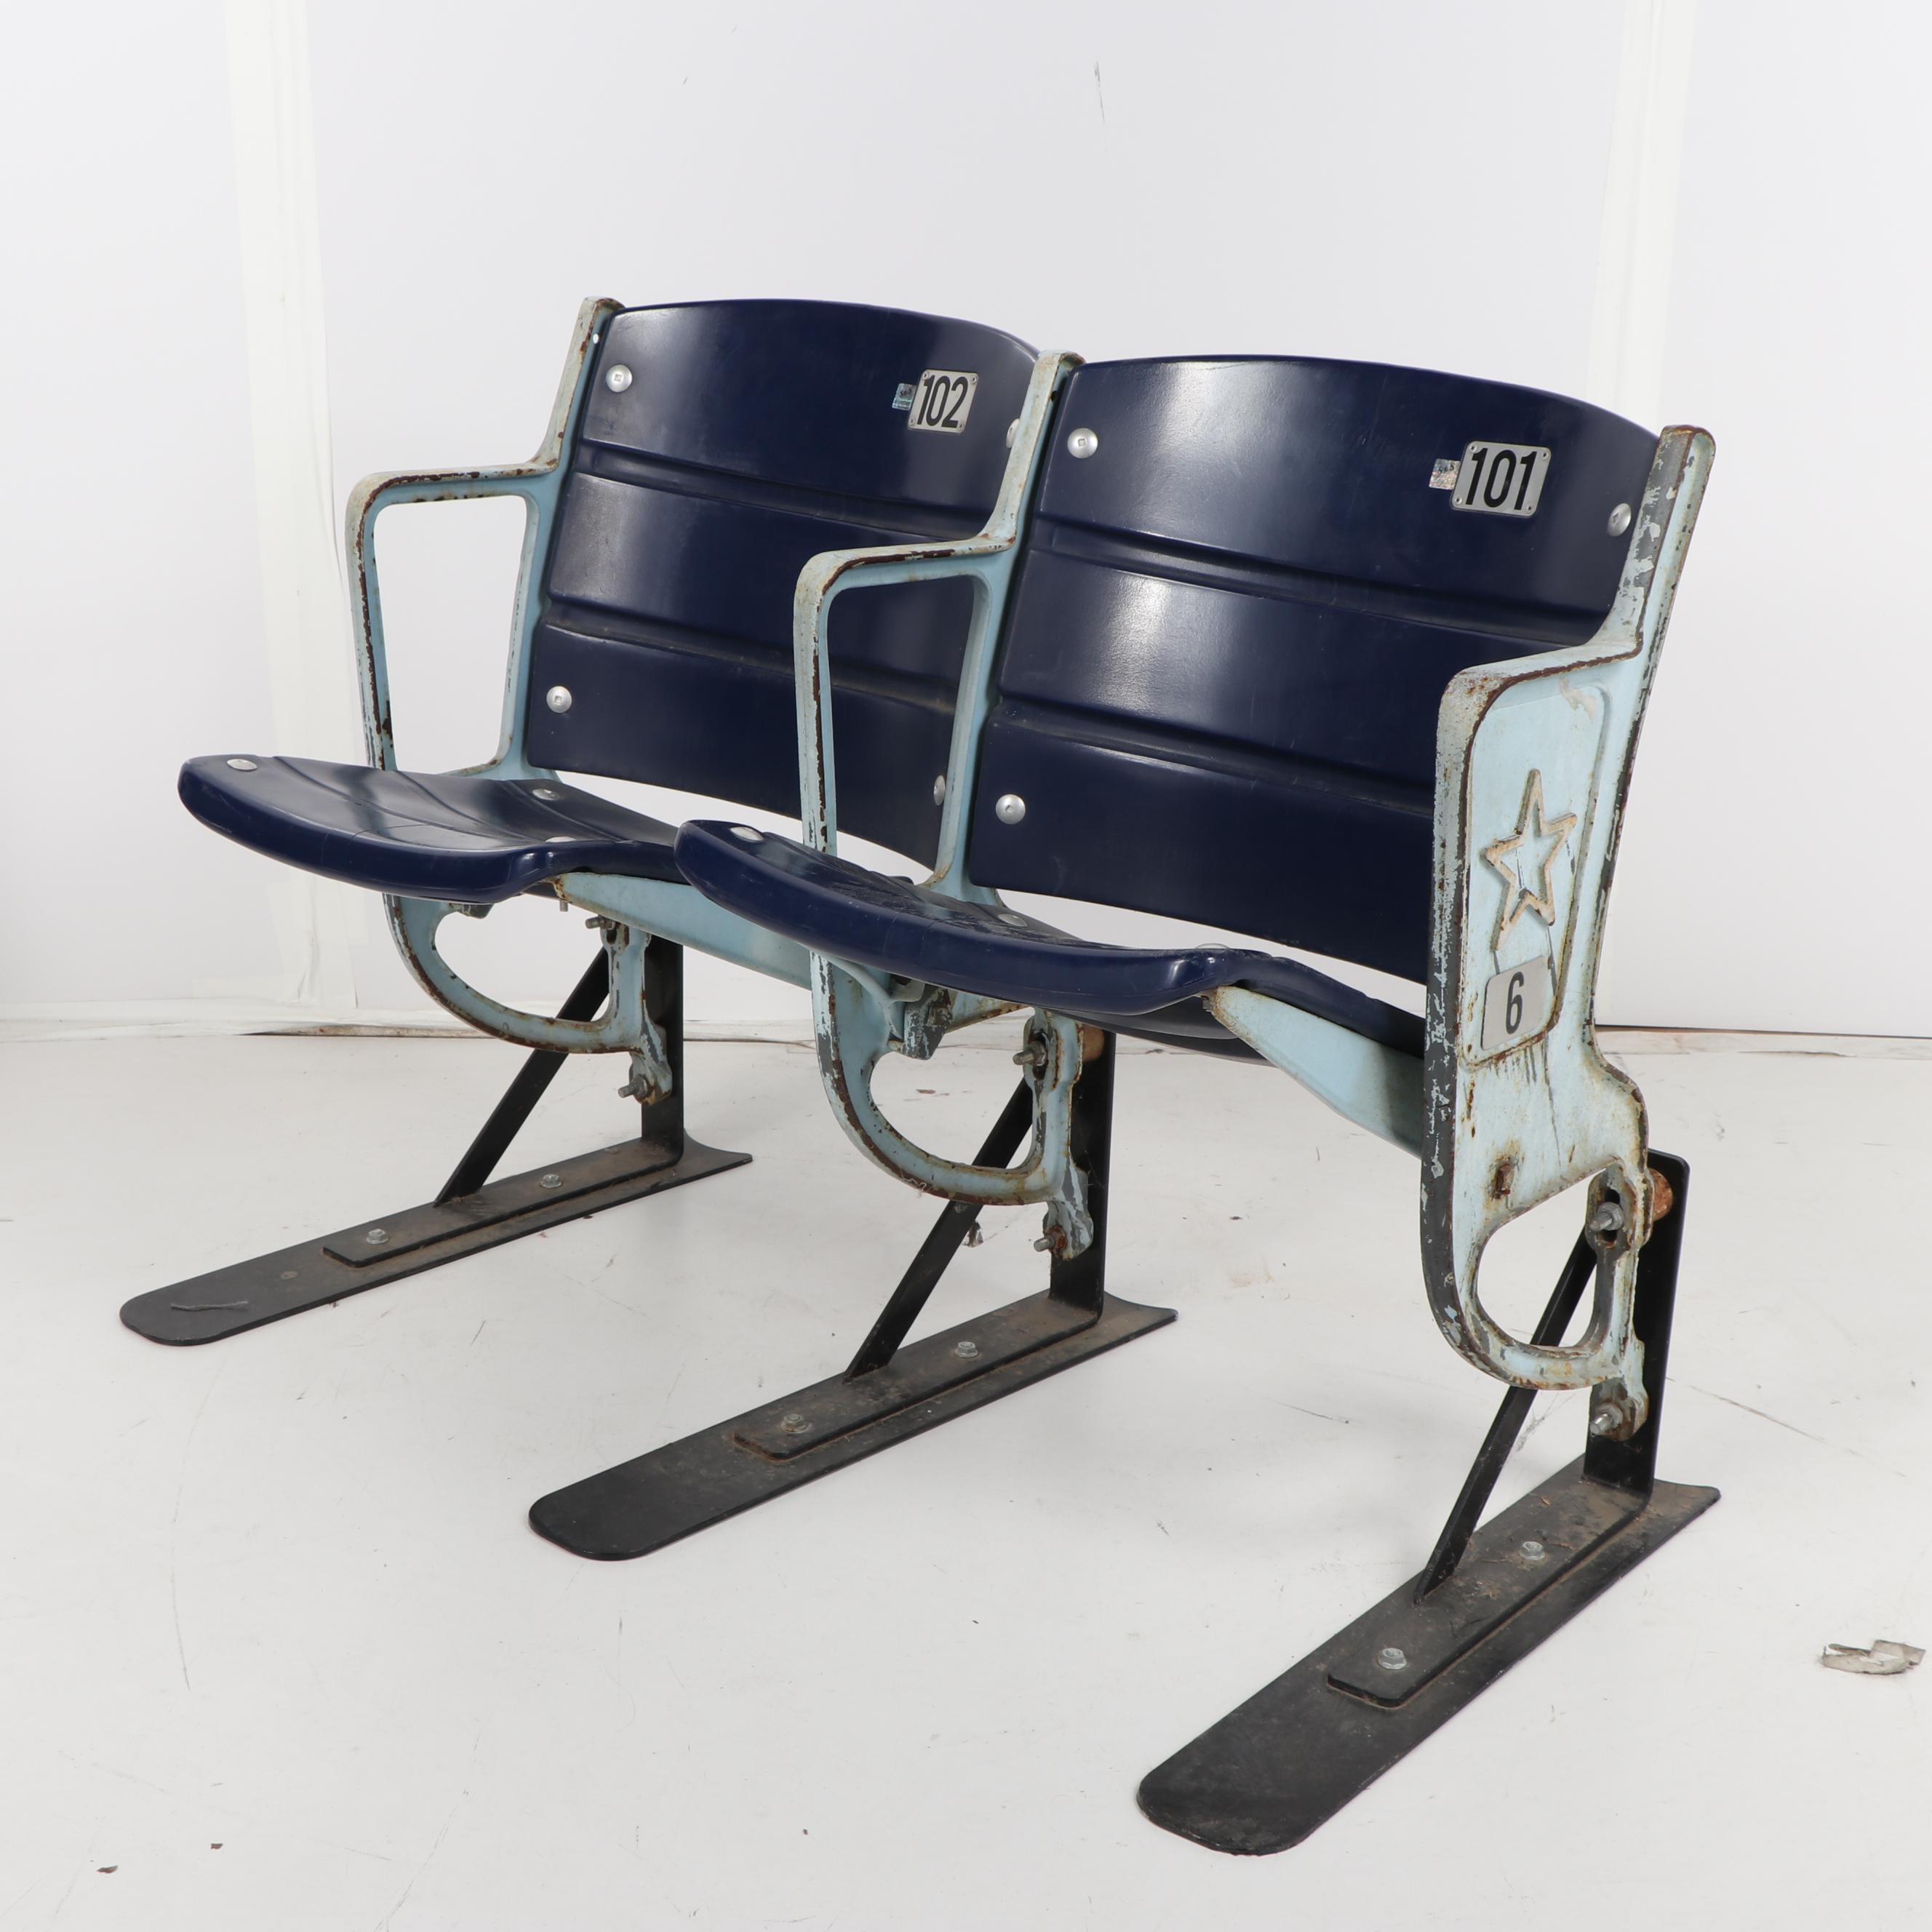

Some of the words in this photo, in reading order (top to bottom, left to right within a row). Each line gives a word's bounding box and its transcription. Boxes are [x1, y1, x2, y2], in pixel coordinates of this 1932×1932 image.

[917, 375, 968, 428] 102
[1466, 447, 1538, 511] 101
[1506, 971, 1525, 1035] 6
